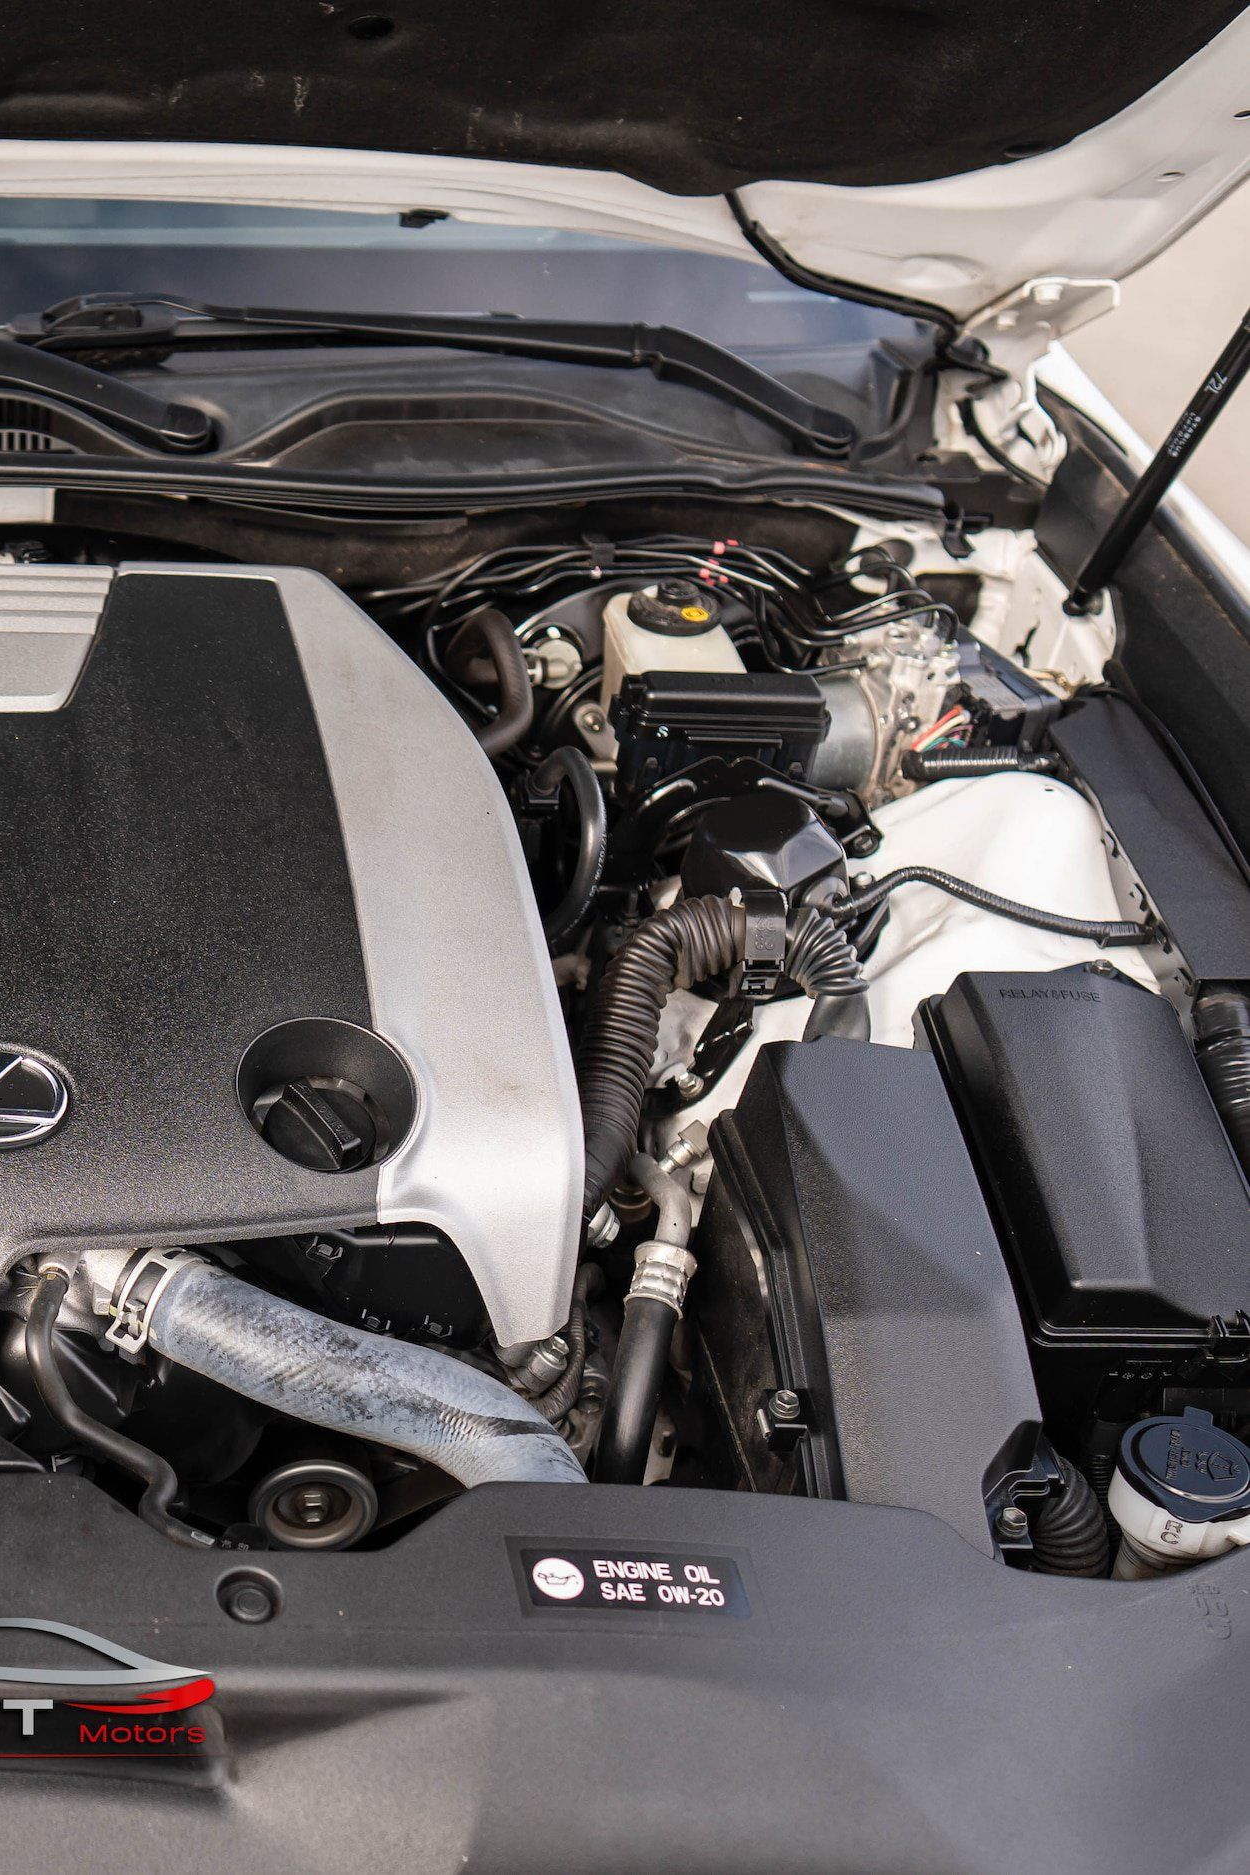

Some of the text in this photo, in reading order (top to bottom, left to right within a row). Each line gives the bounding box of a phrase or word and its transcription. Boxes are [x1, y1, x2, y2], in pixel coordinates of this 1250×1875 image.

[1204, 371, 1228, 394] 72L
[592, 1559, 720, 1584] ENGINE OIL
[600, 1582, 646, 1602] SAE
